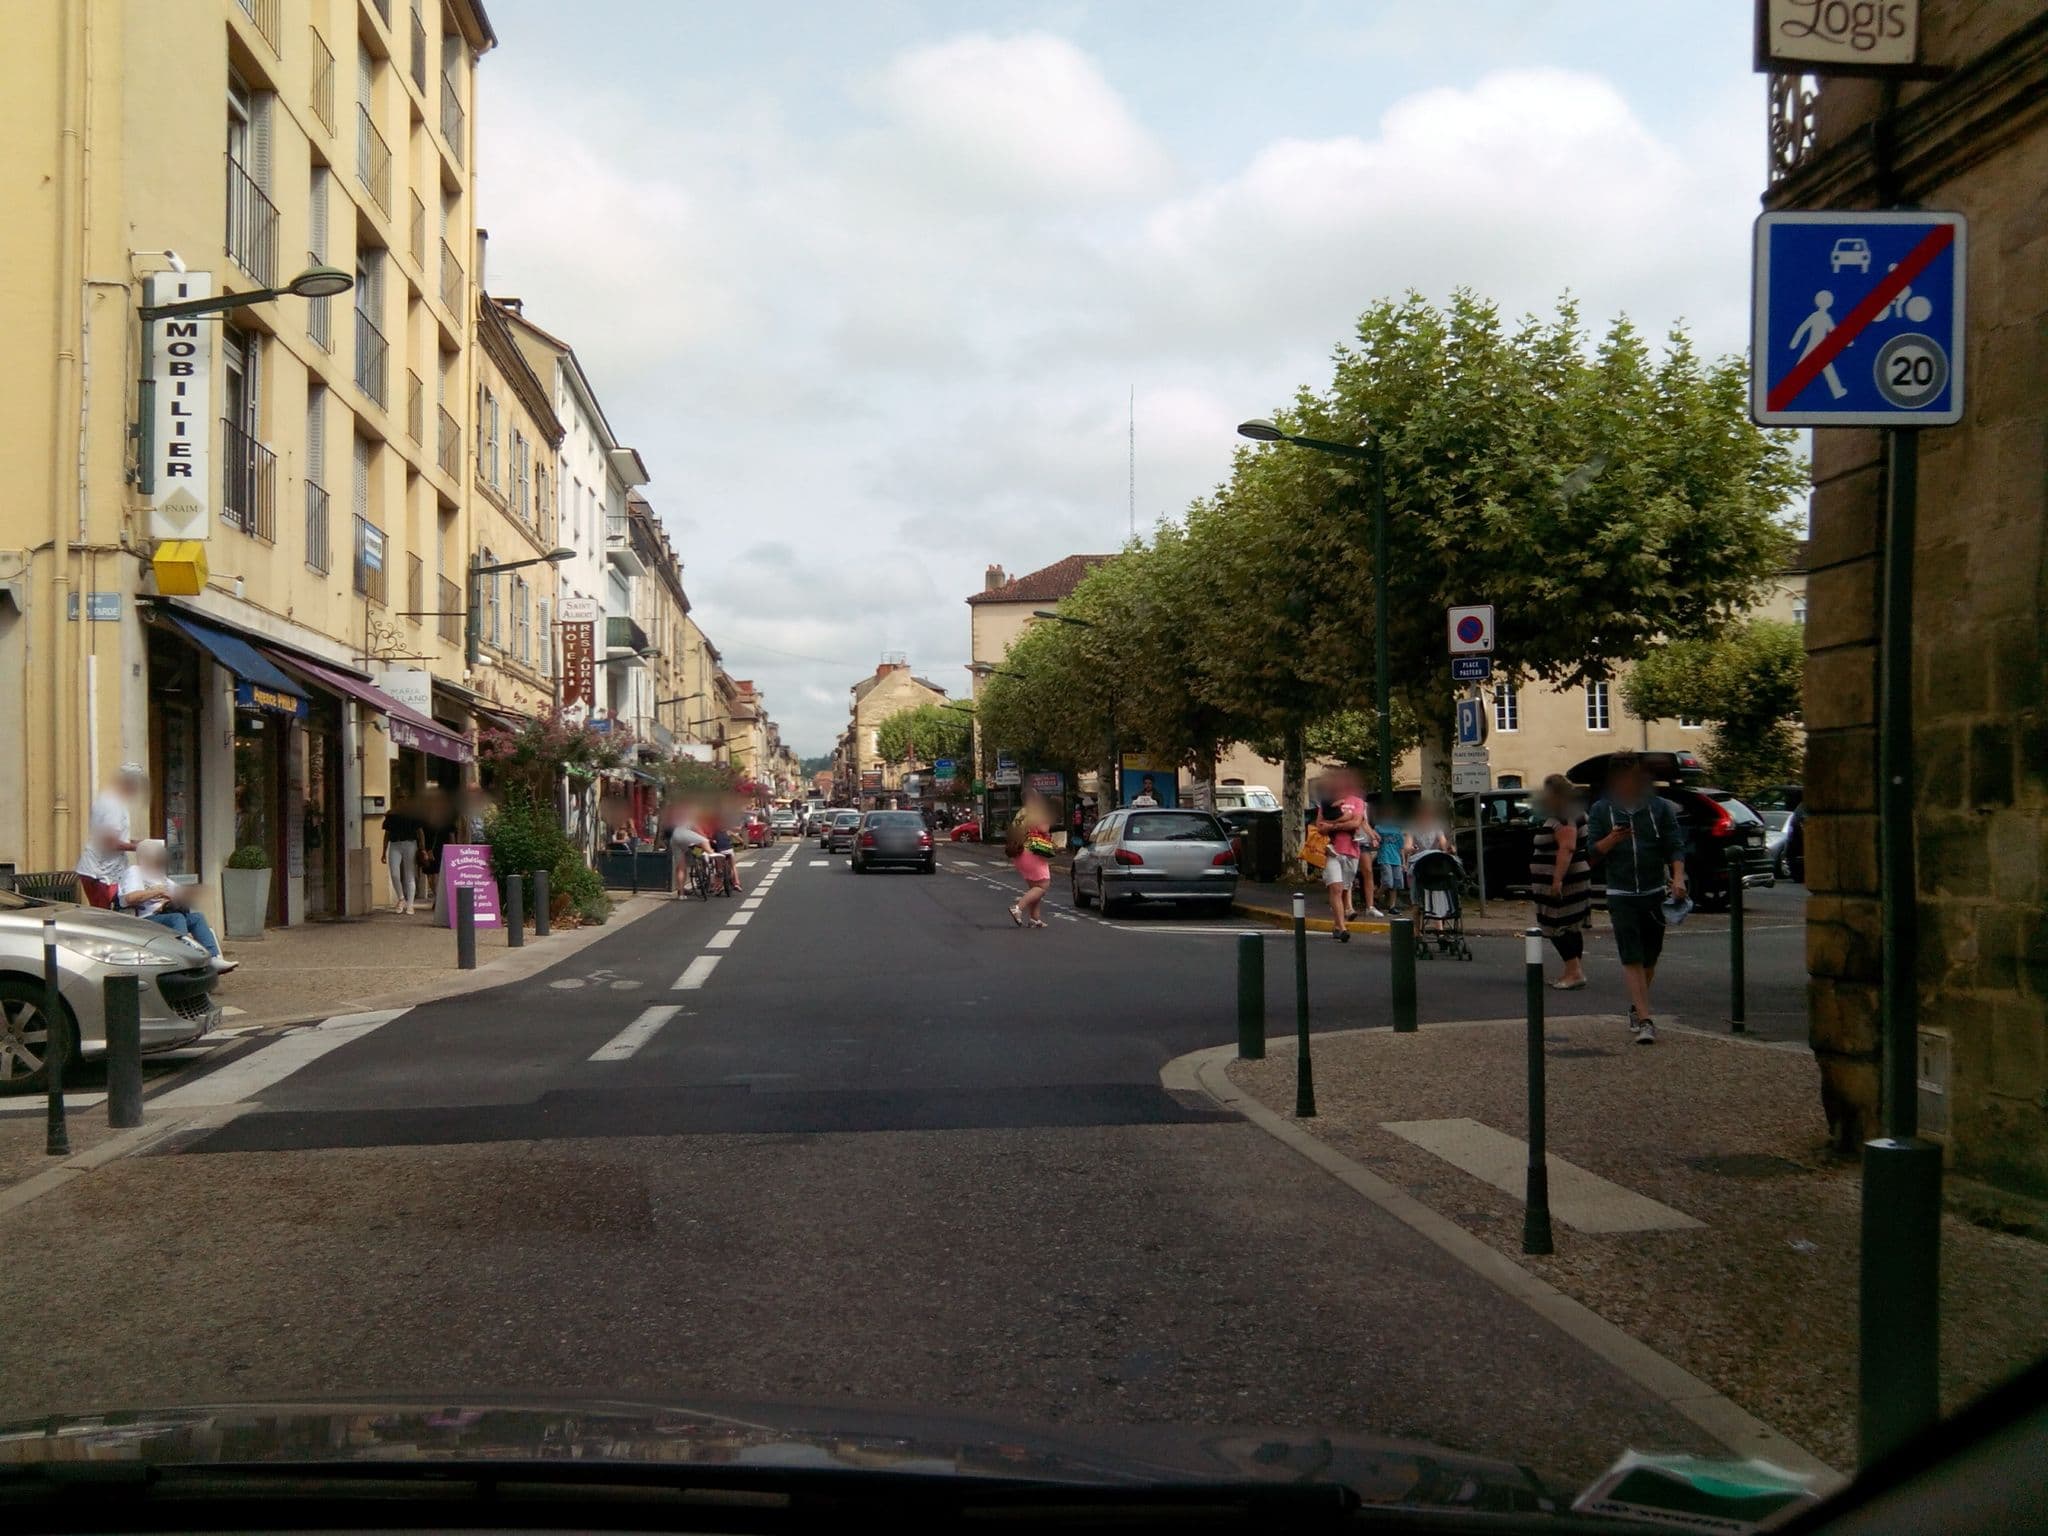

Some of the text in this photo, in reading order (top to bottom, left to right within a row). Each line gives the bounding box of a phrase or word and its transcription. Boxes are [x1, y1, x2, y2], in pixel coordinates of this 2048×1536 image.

[1780, 0, 1905, 51] Logis
[166, 283, 198, 477] IMOBILIER
[1892, 356, 1934, 386] 20
[165, 504, 198, 512] FNAIM
[564, 610, 593, 618] ALBERT
[566, 624, 577, 668] HOTEL
[580, 624, 592, 701] RESTAURANT
[1462, 708, 1473, 735] P
